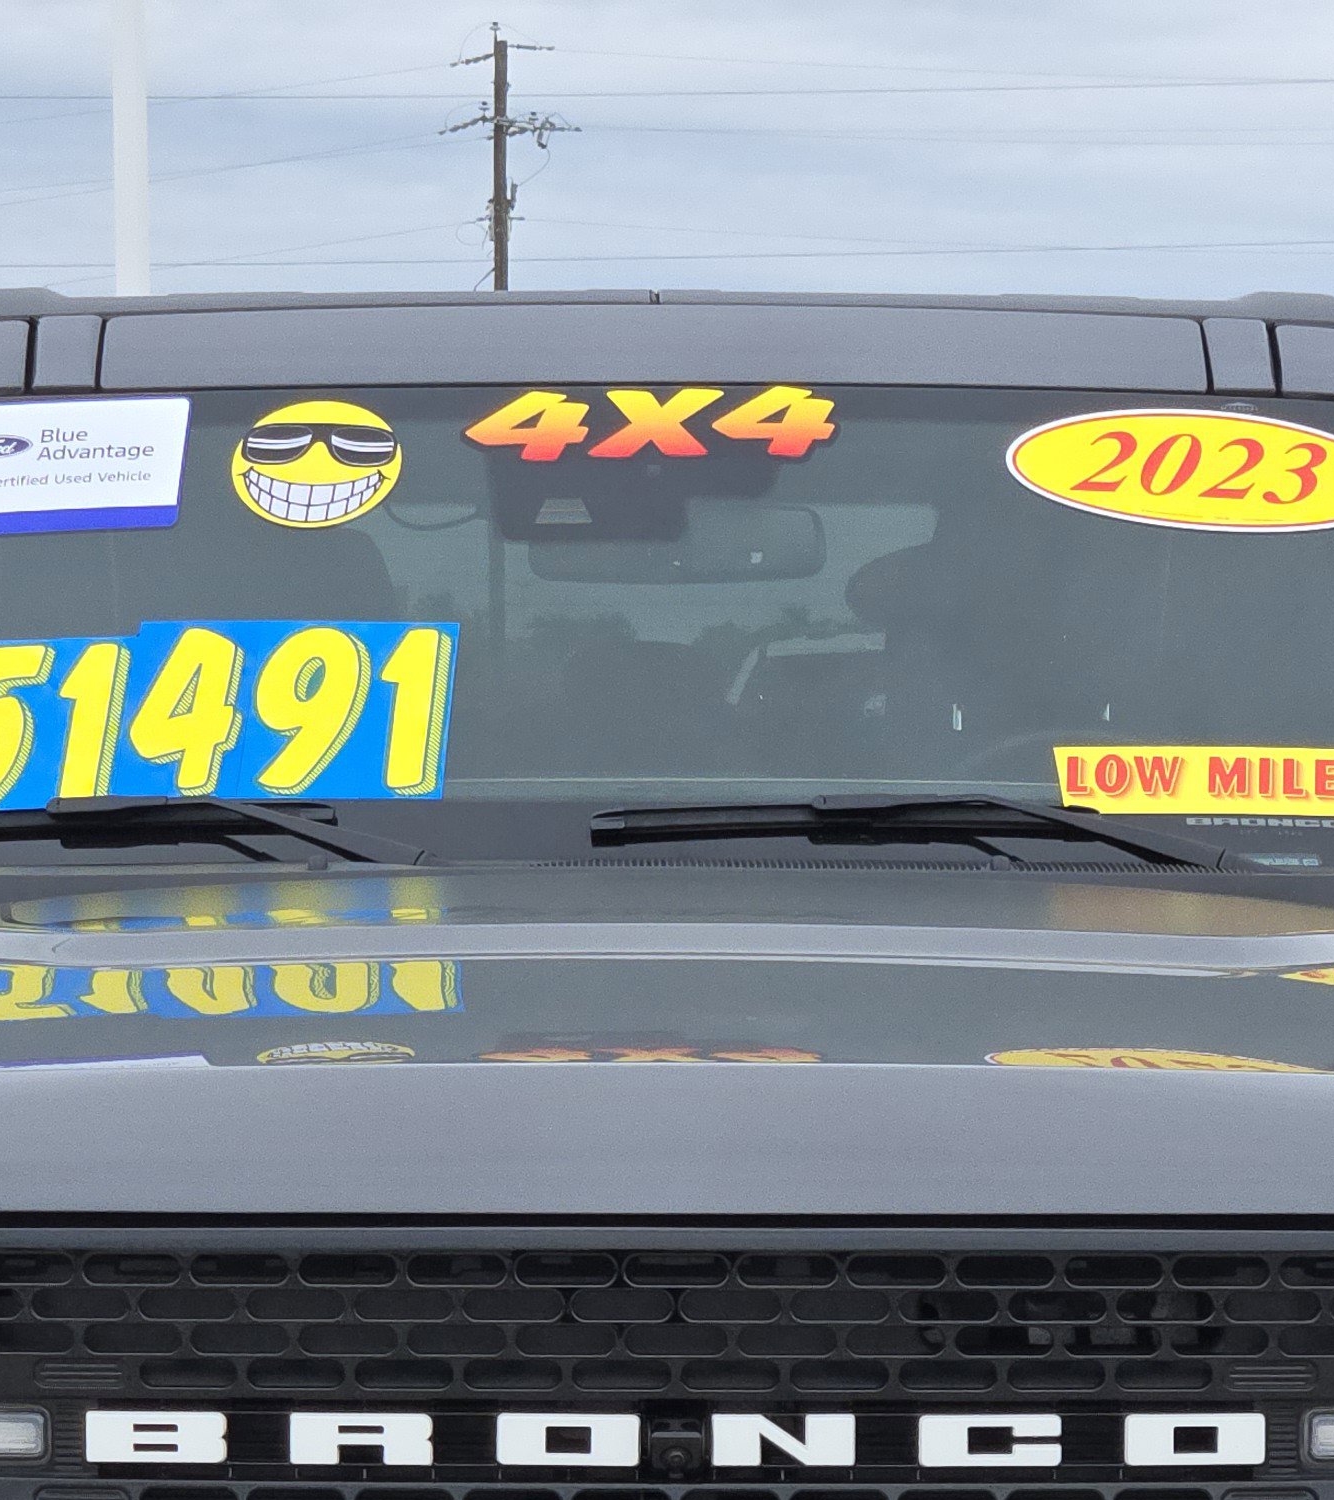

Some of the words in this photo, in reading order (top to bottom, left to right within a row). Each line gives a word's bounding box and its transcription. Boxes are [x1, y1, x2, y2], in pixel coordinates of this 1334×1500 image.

[41, 428, 88, 443] Blue
[467, 386, 835, 461] 4X4
[37, 445, 155, 460] Advantage
[1070, 431, 1327, 505] 2023
[54, 472, 92, 484] Used
[98, 470, 152, 482] Vehicle
[1065, 754, 1183, 797] LOW
[85, 1410, 1265, 1467] BRONCO
